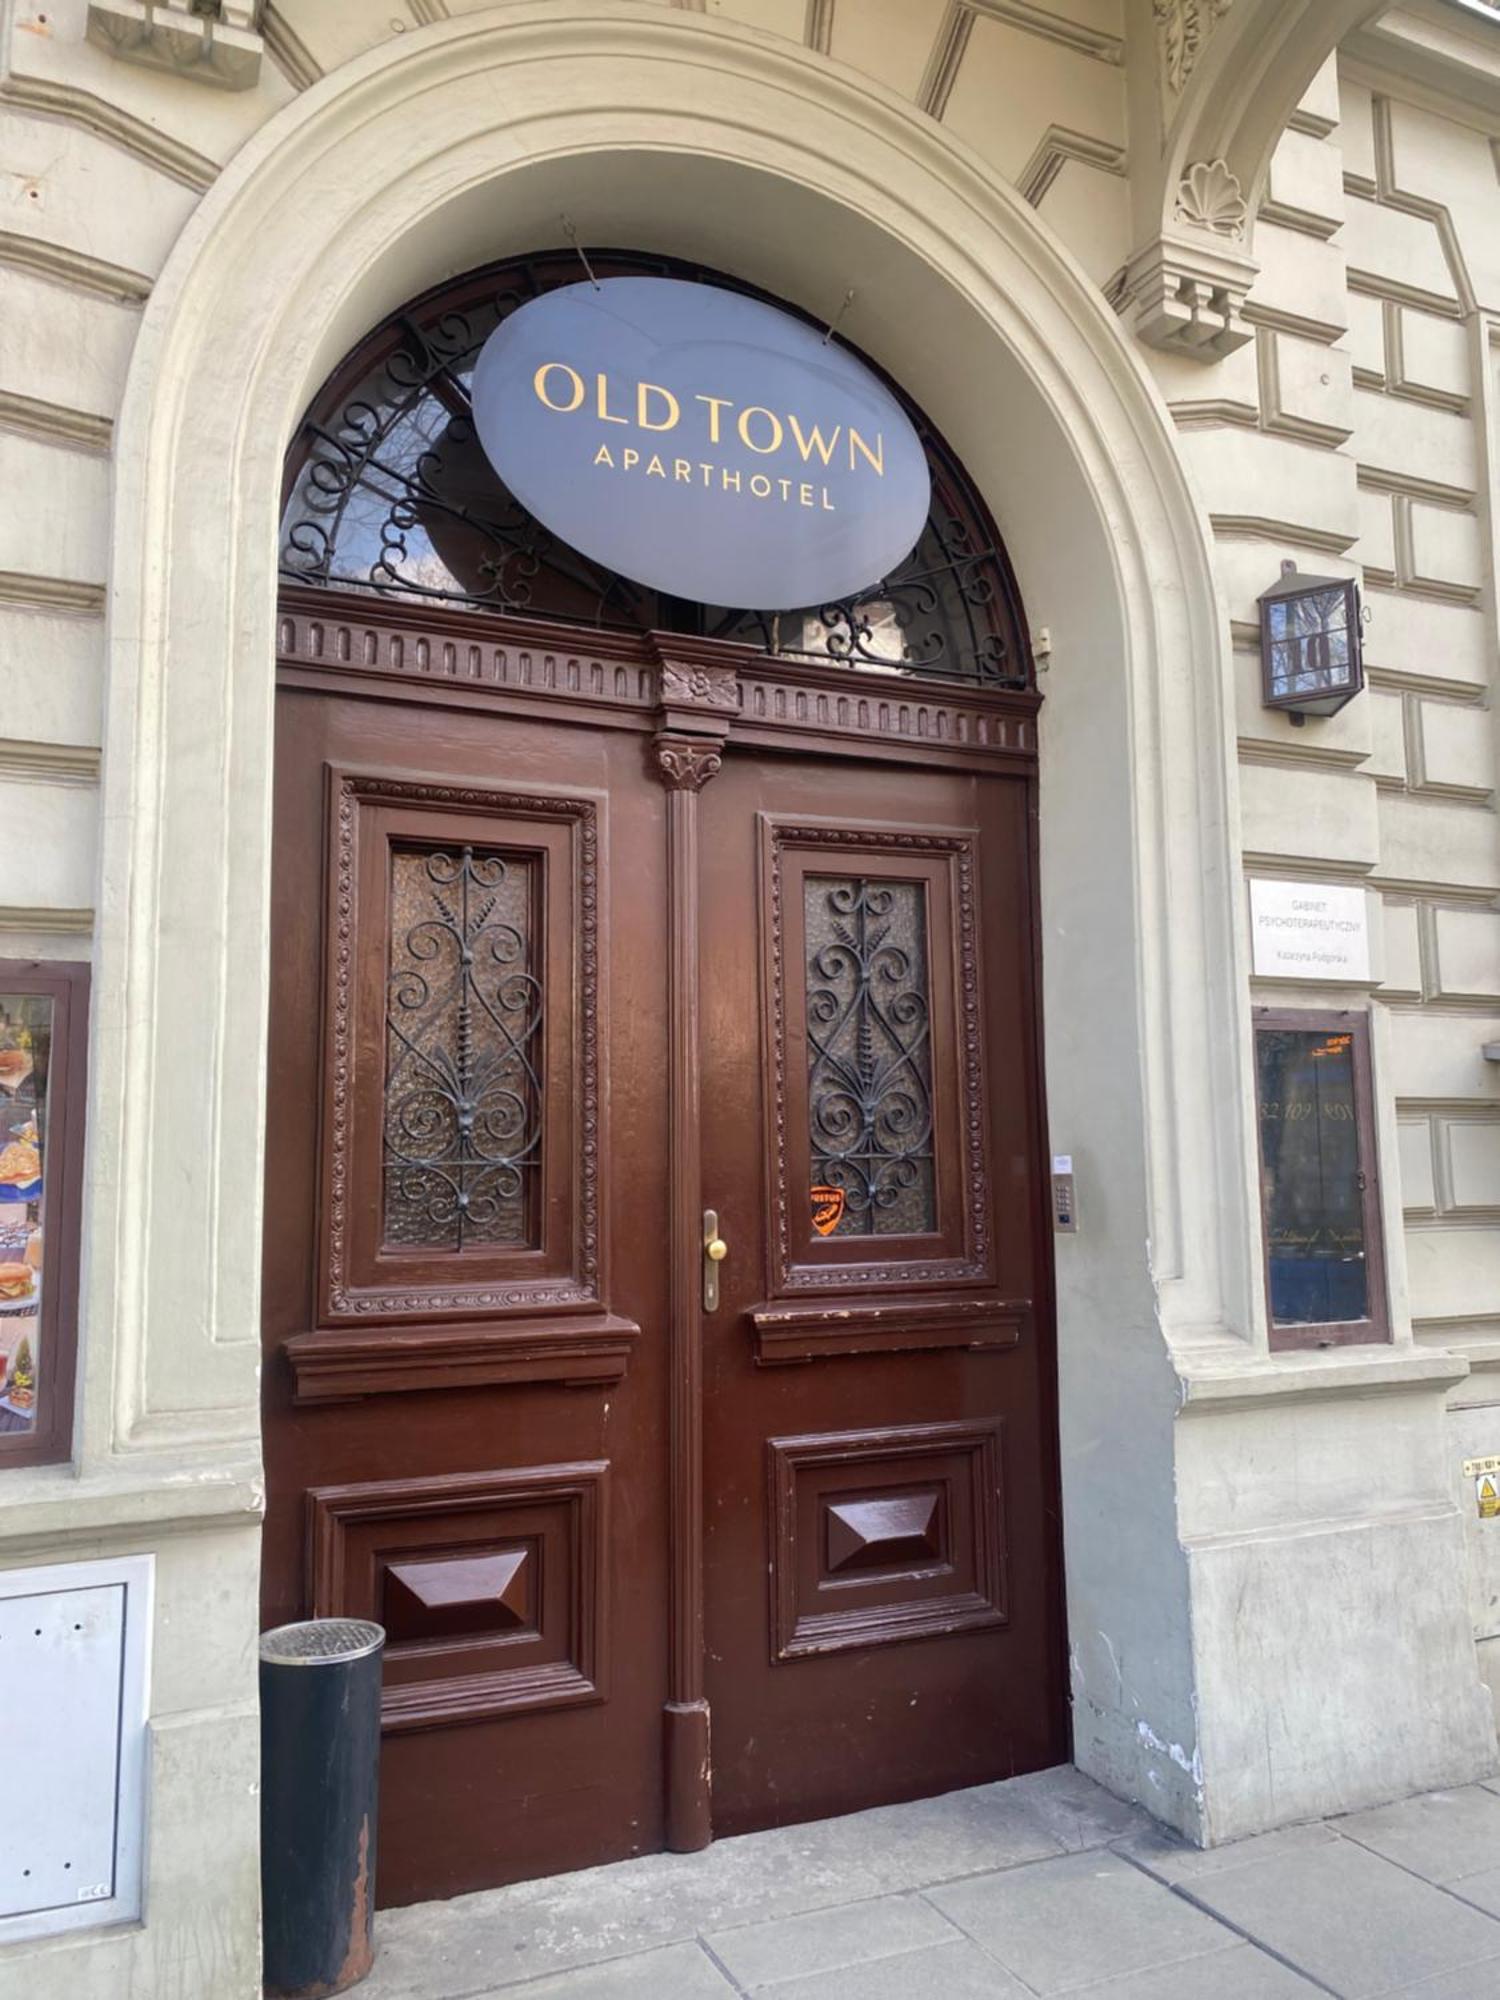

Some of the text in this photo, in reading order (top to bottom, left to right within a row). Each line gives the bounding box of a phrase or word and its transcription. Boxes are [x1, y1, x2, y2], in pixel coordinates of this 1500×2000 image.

[533, 363, 885, 477] OLD TOWN
[594, 444, 836, 510] APARTHOTEL
[1258, 915, 1361, 933] PSYCHOTERAPEUTYCZNY
[1291, 899, 1327, 912] GABINET
